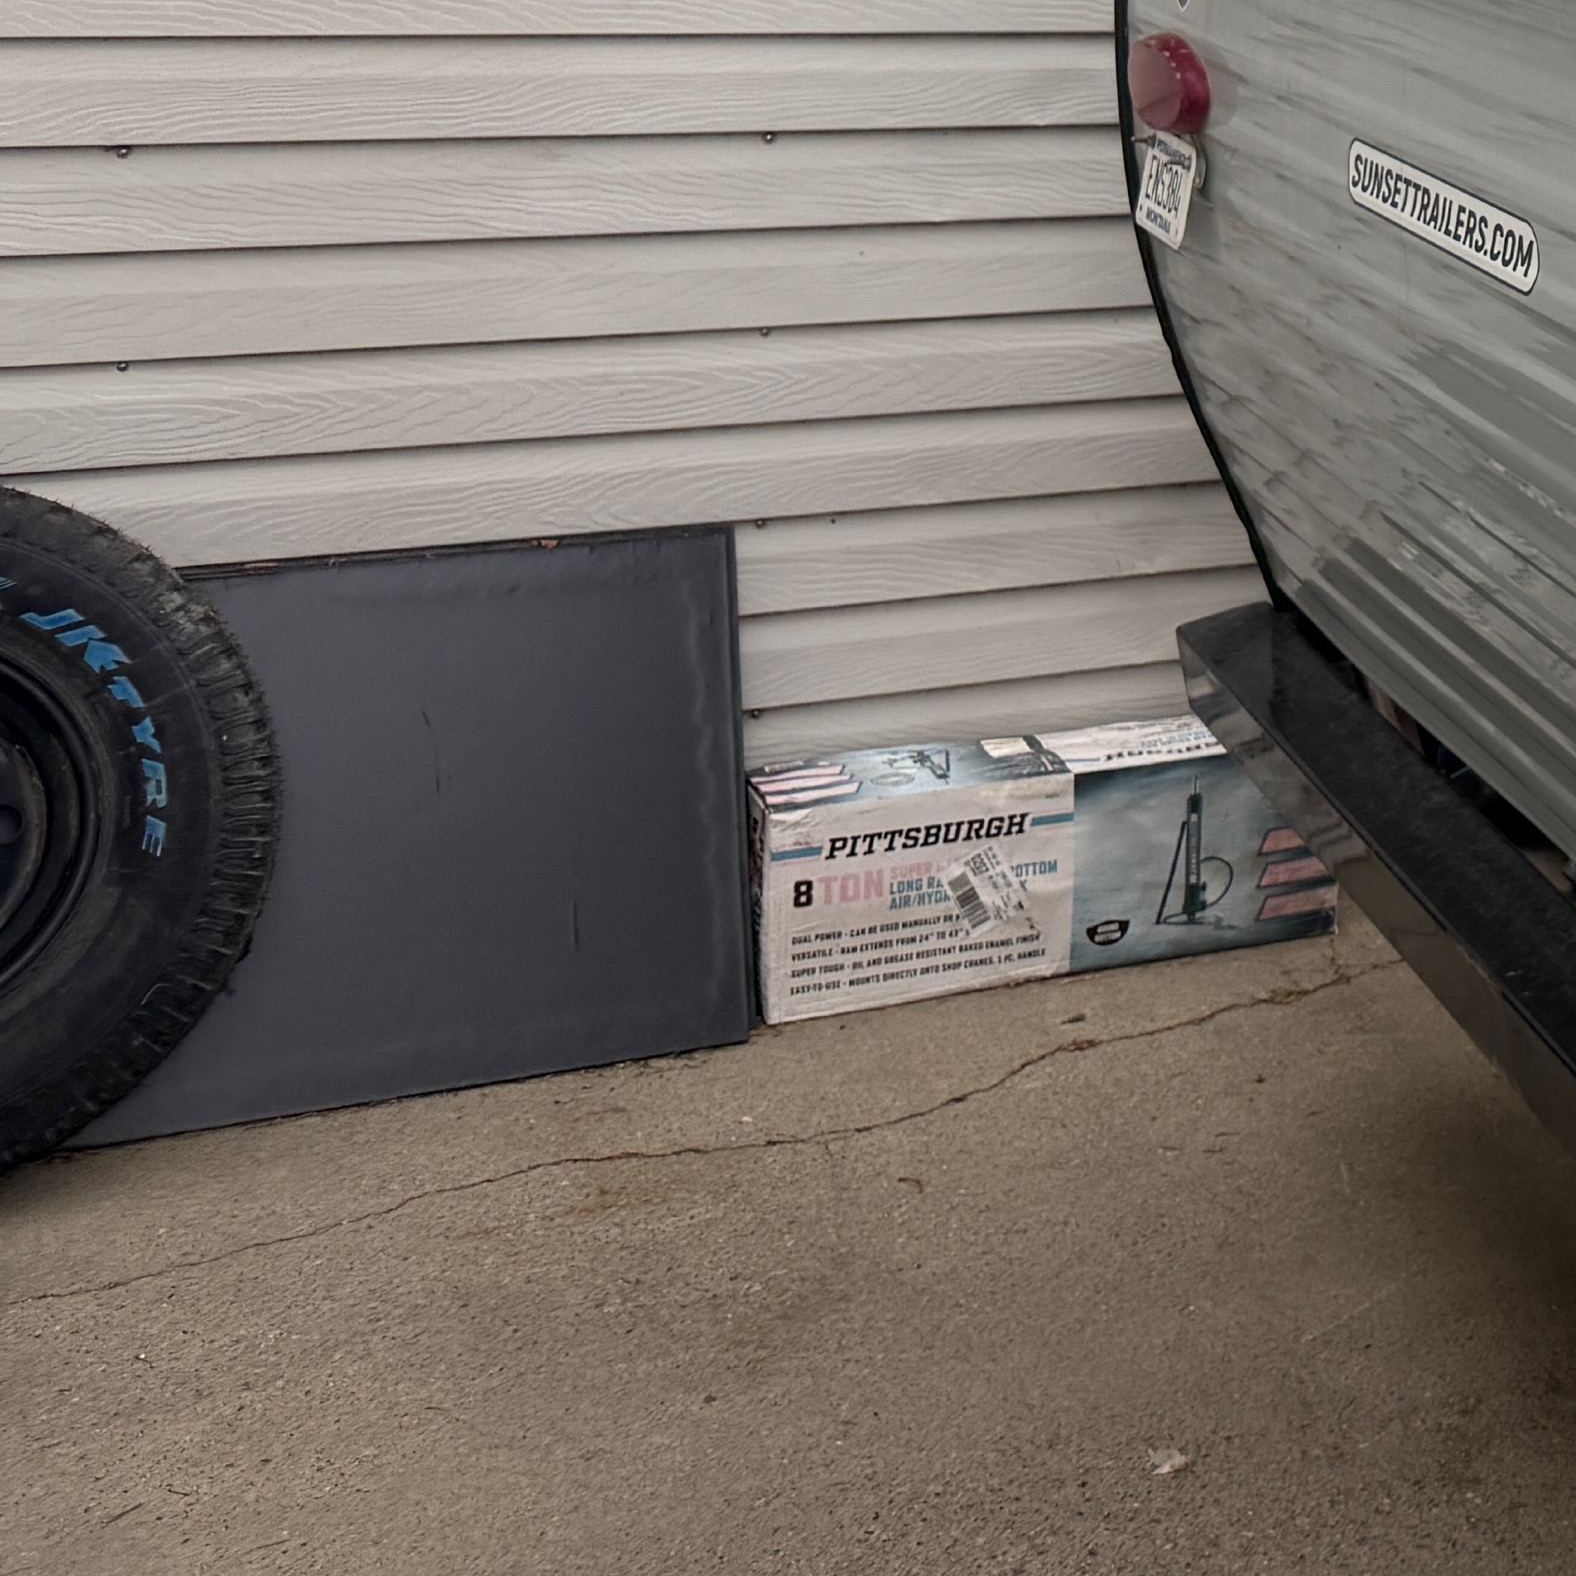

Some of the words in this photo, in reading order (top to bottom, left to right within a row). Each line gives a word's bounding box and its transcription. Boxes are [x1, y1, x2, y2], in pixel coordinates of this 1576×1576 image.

[1351, 153, 1534, 278] SUNSETTRAILERS.COM
[825, 812, 1032, 860] PITTSBURGH
[1011, 859, 1058, 878] OTTOM
[793, 880, 813, 908] 8
[818, 869, 884, 905] TON
[889, 879, 923, 895] LONG
[814, 931, 842, 941] POWER
[850, 928, 866, 937] CAN
[880, 922, 900, 932] USED
[902, 915, 941, 929] MANUALLY
[791, 948, 833, 962] VERSATILE
[860, 939, 893, 953] EXTENDS
[896, 935, 917, 946] FROM
[791, 967, 816, 978] SUPER
[884, 952, 913, 964] GREASE
[916, 946, 956, 959] RESISTANT
[959, 941, 984, 953] BAKED
[849, 974, 880, 987] MOUNTS
[883, 968, 918, 982] DIRECTLY
